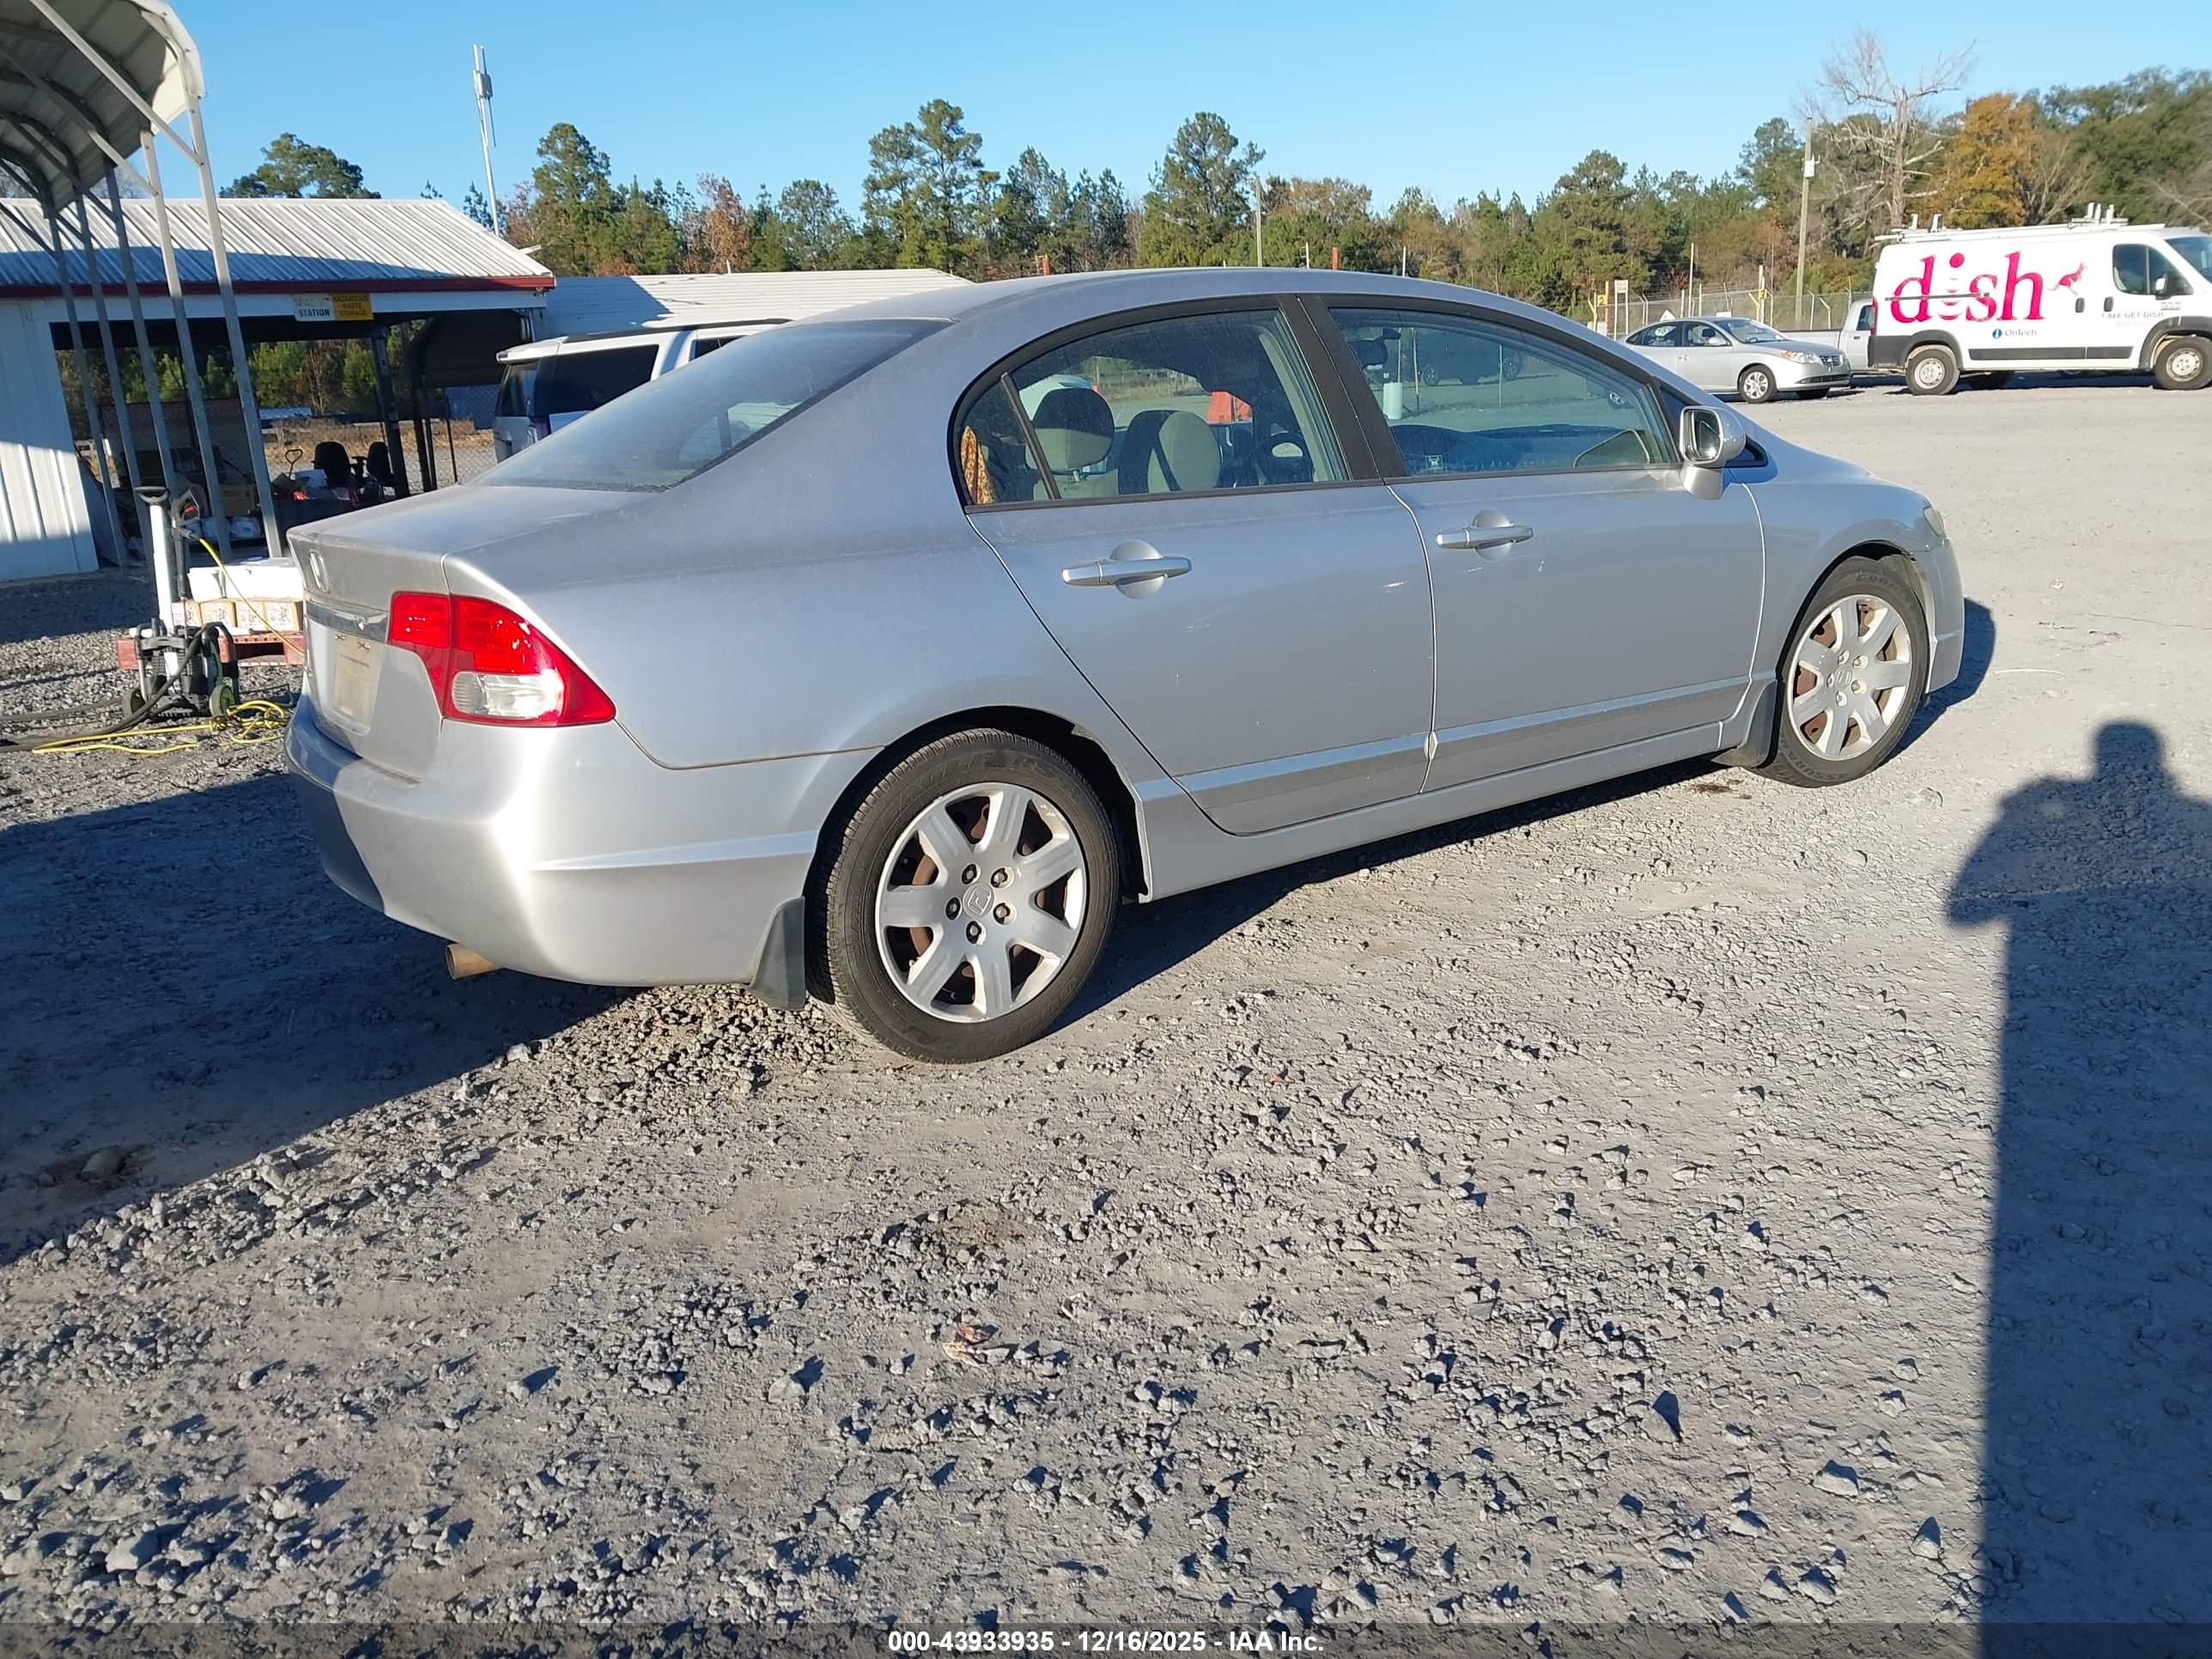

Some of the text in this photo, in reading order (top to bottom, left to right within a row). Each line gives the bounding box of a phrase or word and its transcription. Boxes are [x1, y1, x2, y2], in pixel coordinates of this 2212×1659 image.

[1890, 250, 2045, 324] dish
[298, 308, 330, 317] STATION
[2004, 329, 2037, 337] OnTech
